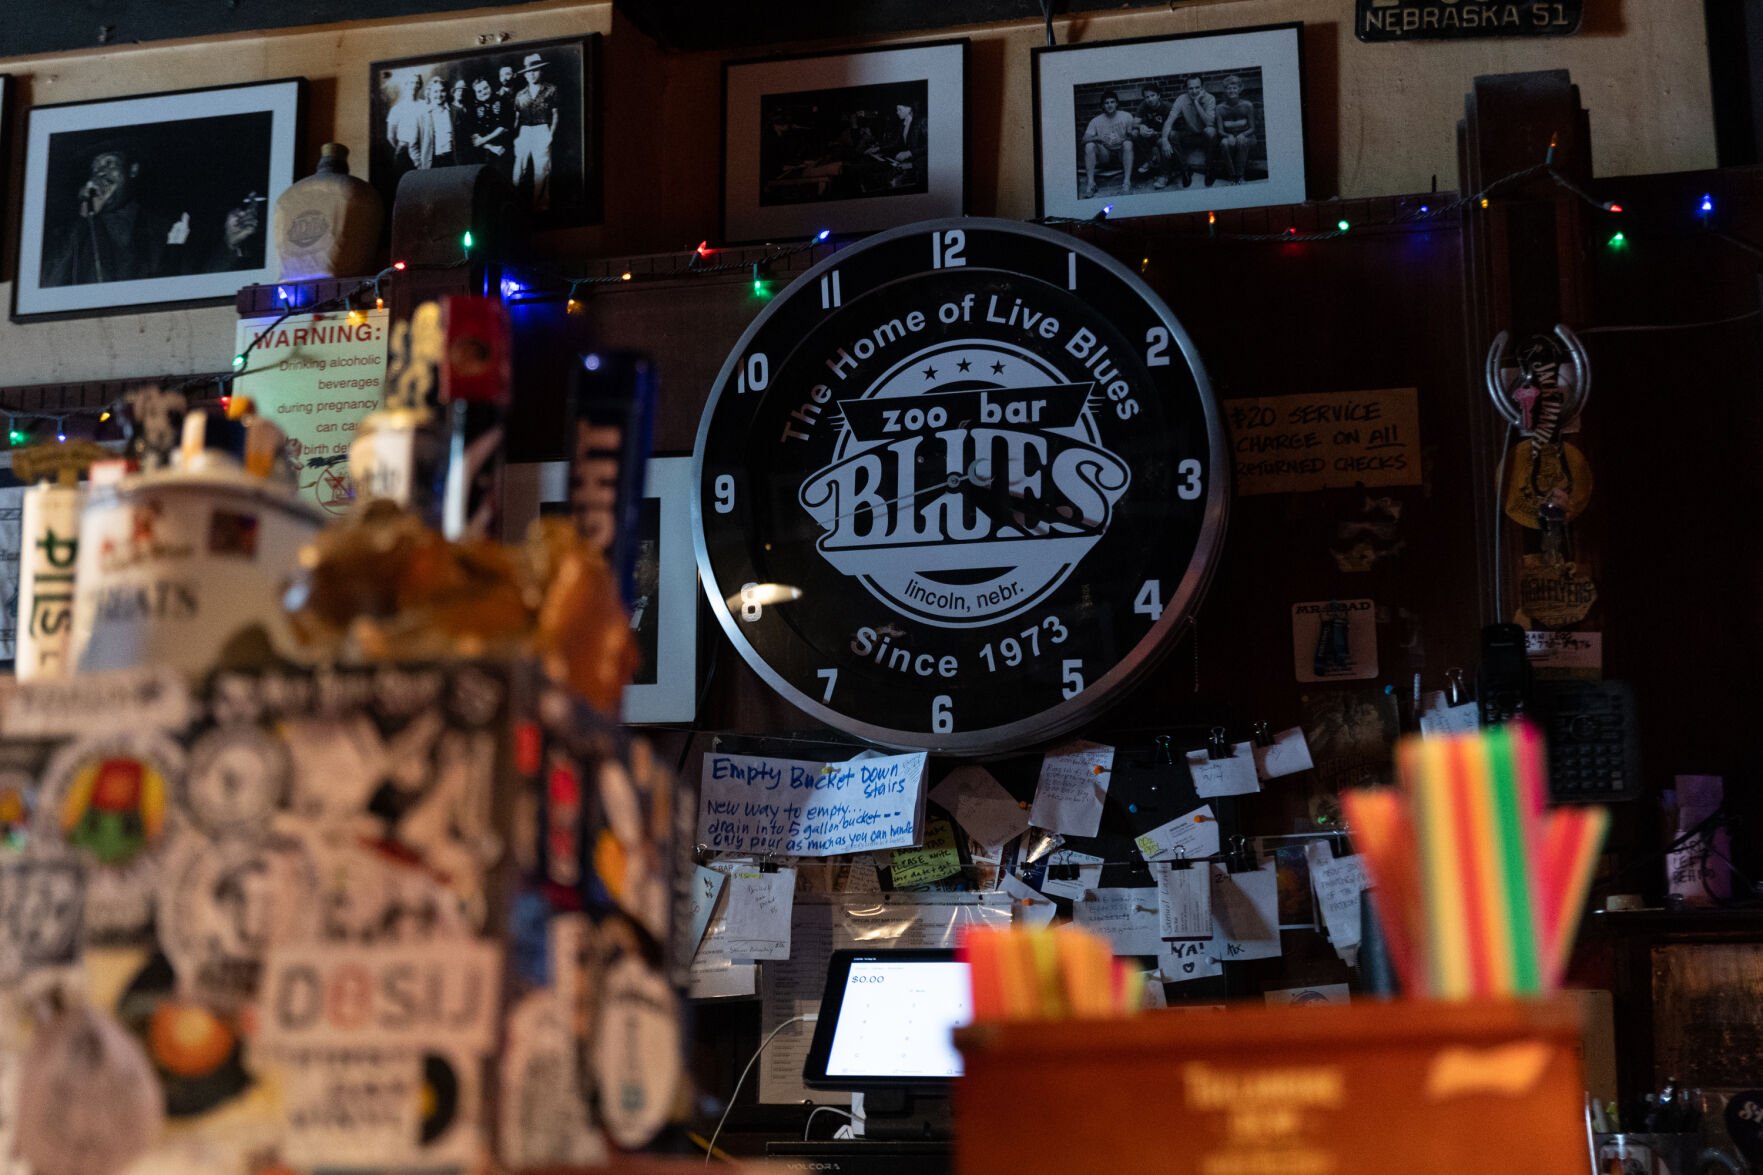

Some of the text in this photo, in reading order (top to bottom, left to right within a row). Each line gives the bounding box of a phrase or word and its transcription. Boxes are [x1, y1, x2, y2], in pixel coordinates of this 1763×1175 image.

[1366, 4, 1569, 32] NEBRASKA 51
[933, 230, 966, 269] 12
[1068, 252, 1077, 290] 1
[821, 271, 841, 309] 11
[254, 323, 382, 349] WARNING:
[1146, 327, 1170, 367] 2
[280, 355, 382, 371] Drinking alcoholic
[737, 353, 769, 393] 10
[781, 294, 1141, 444] The Home of Live Blues
[318, 377, 380, 390] beverages
[277, 399, 379, 415] during pregnancy
[882, 392, 1046, 432] zoo bar
[1231, 401, 1382, 429] $20 SERVICE
[316, 423, 338, 433] can
[1237, 431, 1322, 452] CHARGE
[1333, 429, 1361, 445] ON
[303, 444, 329, 455] birth
[1334, 454, 1408, 472] CHECKS
[714, 474, 736, 514] 9
[800, 427, 1131, 552] BLUES
[1178, 459, 1202, 500] 3
[904, 578, 1026, 614] lincoln, nebr.
[1134, 579, 1164, 621] 4
[851, 615, 1069, 678] Since 1973
[817, 669, 839, 704] 7
[1062, 659, 1084, 700] 5
[932, 695, 954, 734] 6
[712, 758, 898, 791] Empty Bucket Down
[707, 801, 740, 815] New
[783, 802, 801, 818] to
[708, 819, 749, 835] drain
[788, 822, 801, 836] 5
[803, 822, 838, 840] gallon
[750, 837, 782, 851] pour
[786, 839, 802, 851] as
[849, 833, 867, 848] you
[871, 830, 887, 843] can
[851, 975, 885, 984] $0.00
